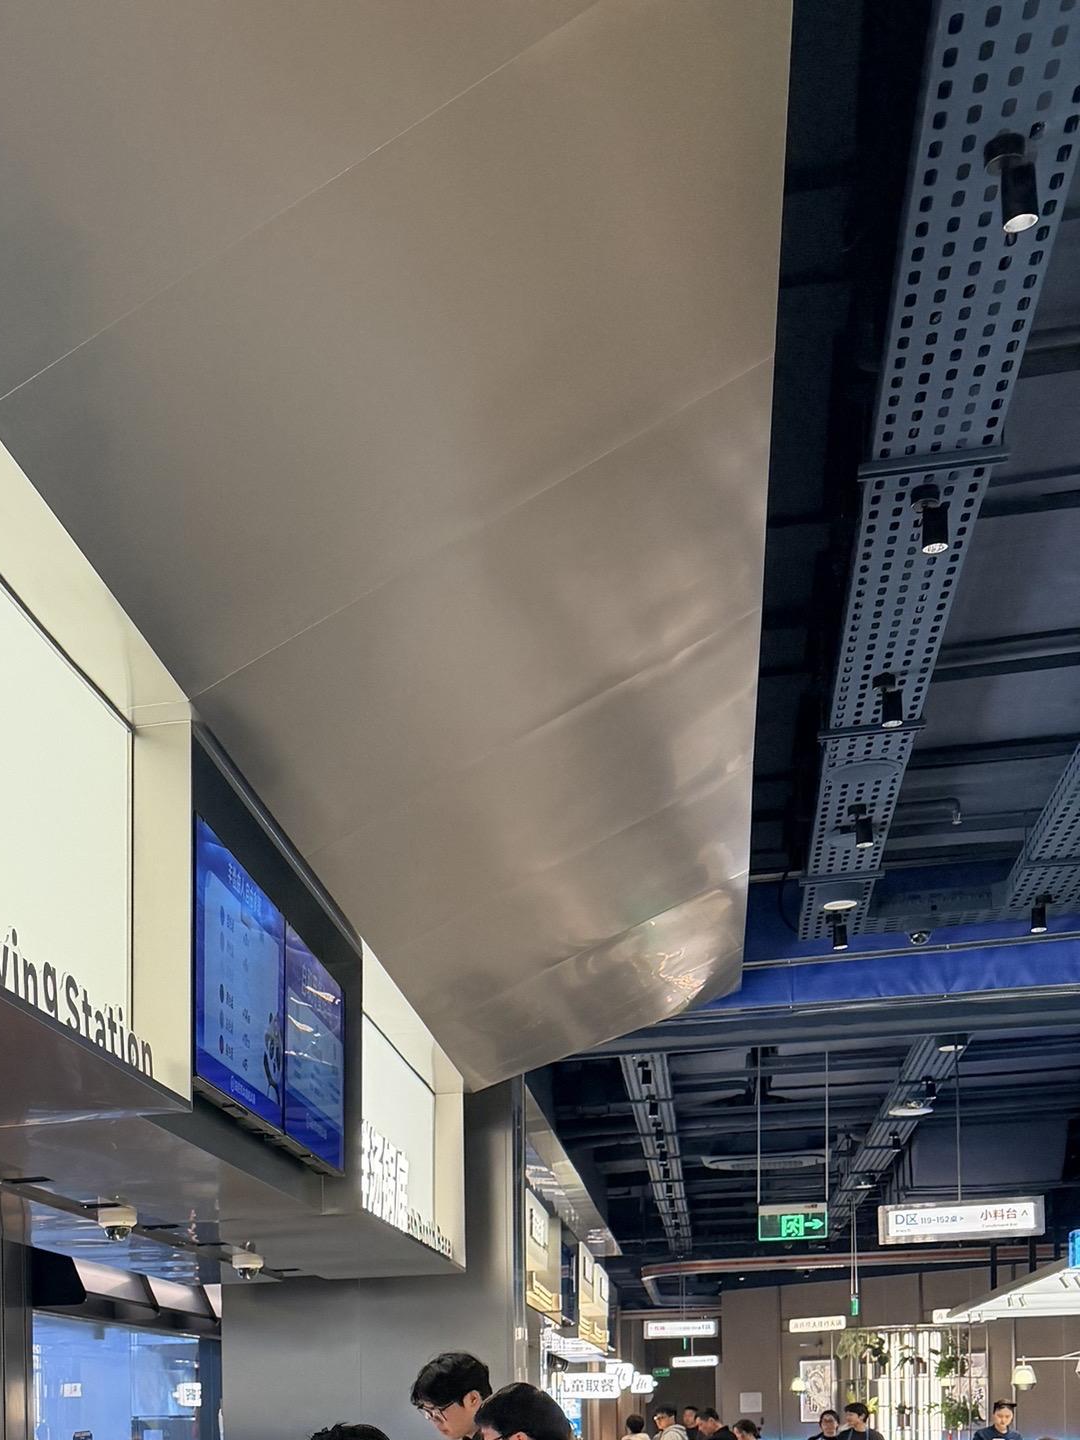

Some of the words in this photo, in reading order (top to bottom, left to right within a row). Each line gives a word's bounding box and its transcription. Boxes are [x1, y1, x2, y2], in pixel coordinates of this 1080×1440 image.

[64, 973, 154, 1079] Station
[895, 1213, 918, 1226] D区
[980, 1208, 1017, 1221] 小料台
